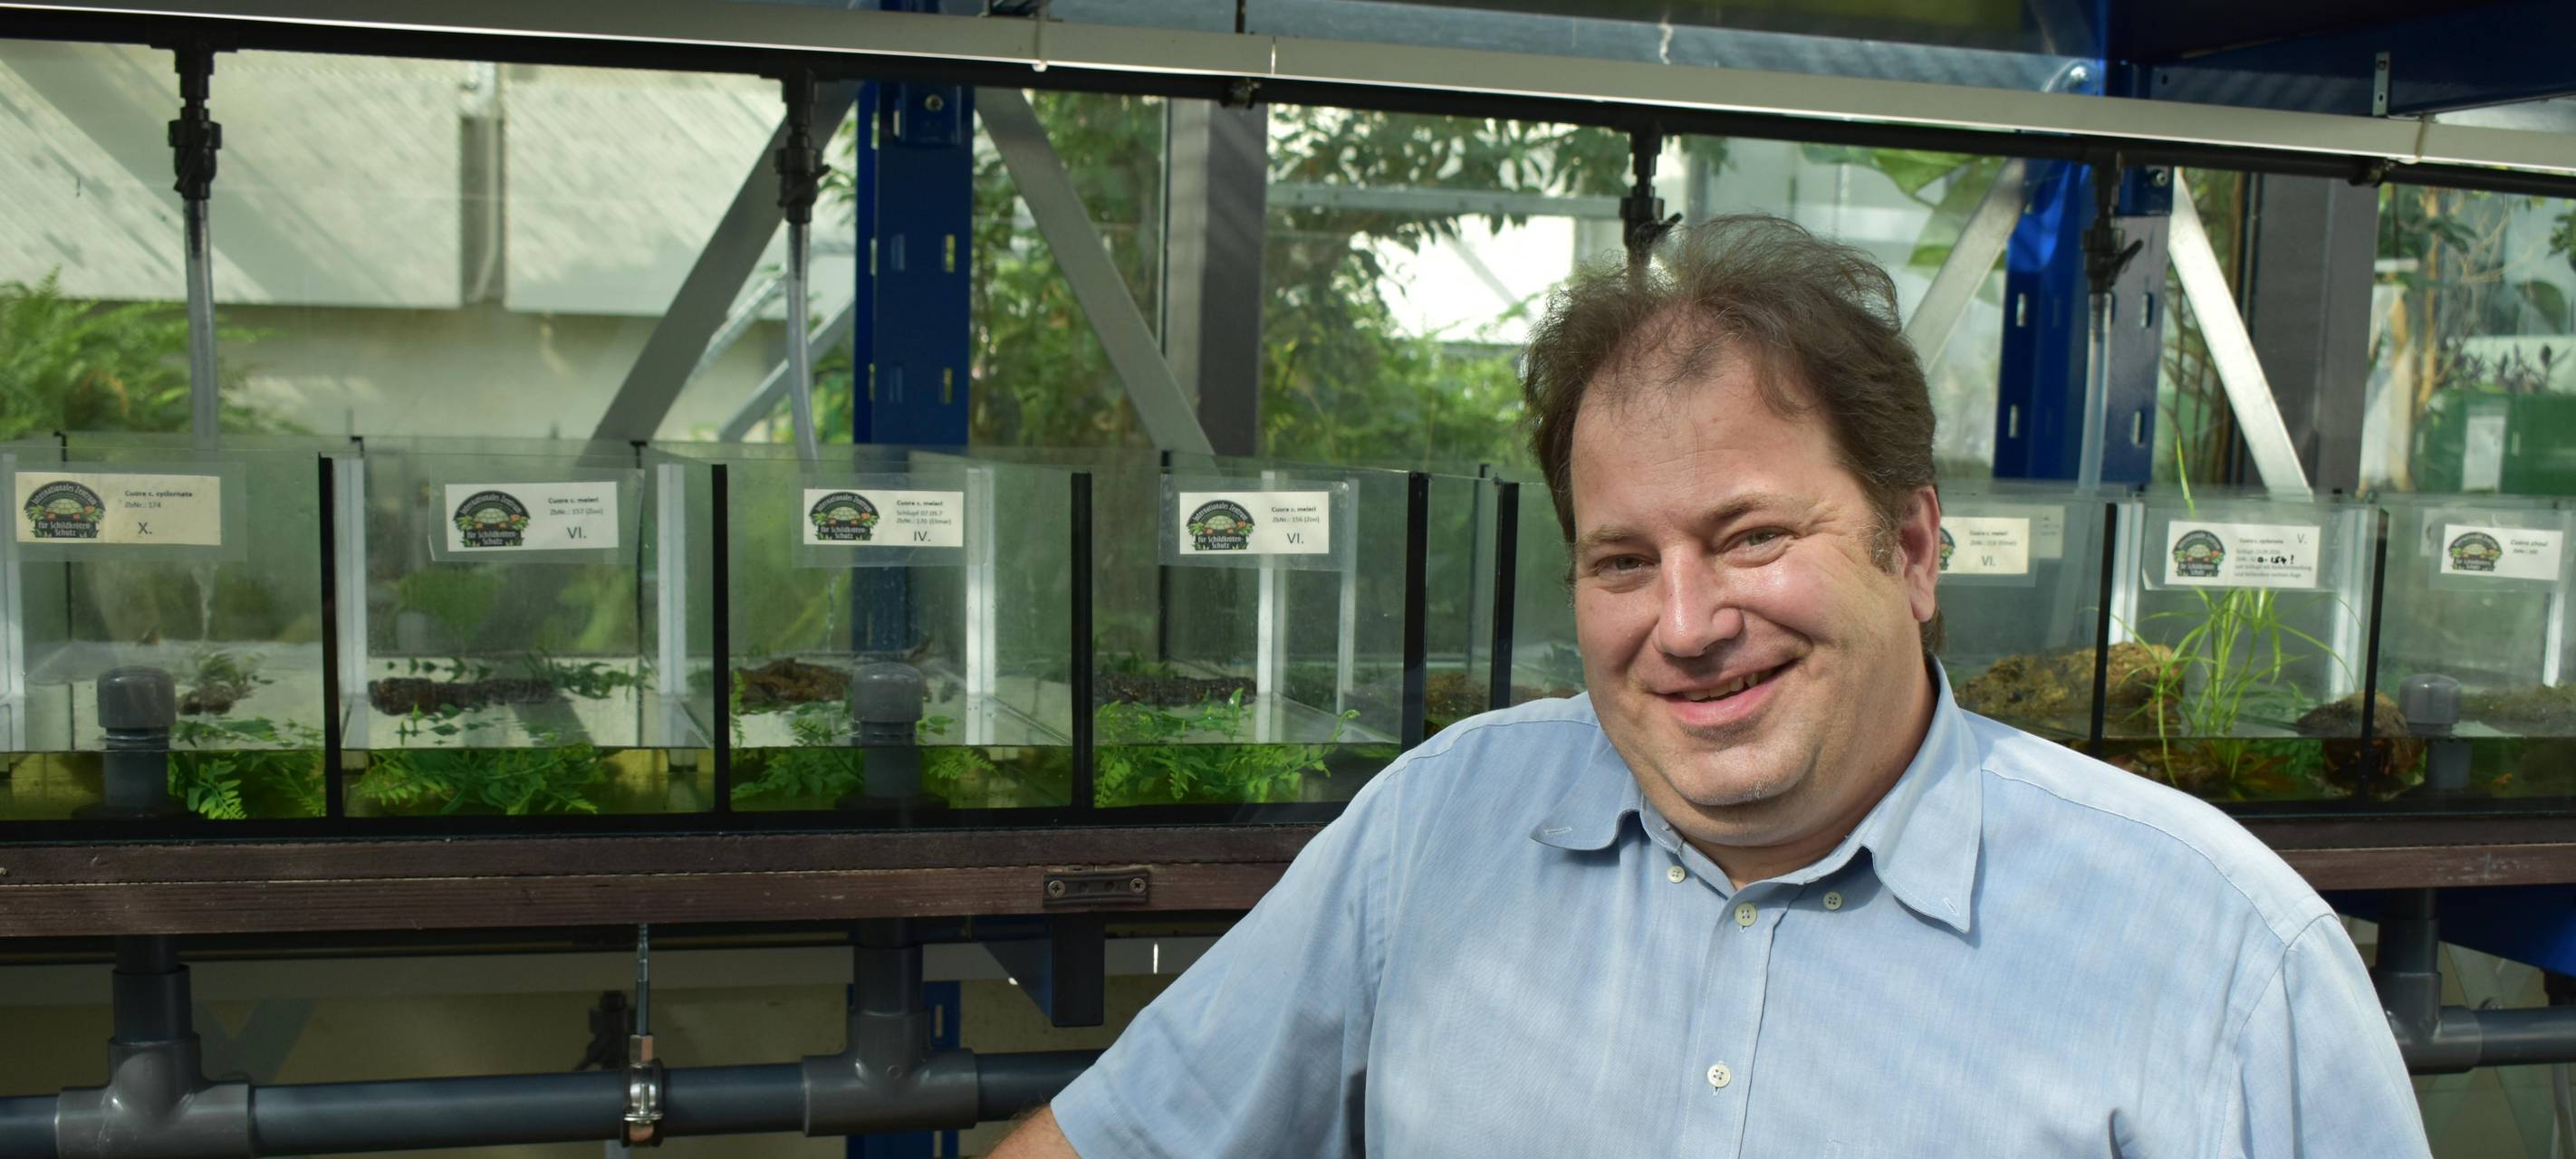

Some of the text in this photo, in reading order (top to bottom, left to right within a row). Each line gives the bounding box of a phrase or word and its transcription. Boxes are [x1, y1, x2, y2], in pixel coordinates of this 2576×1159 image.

[31, 484, 98, 505] Internationales Zentrum
[38, 522, 49, 530] für
[138, 522, 152, 534] X.
[566, 526, 587, 539] VI.
[914, 531, 931, 541] IV.
[1287, 532, 1304, 543] VI.
[1981, 555, 1996, 566] VI.
